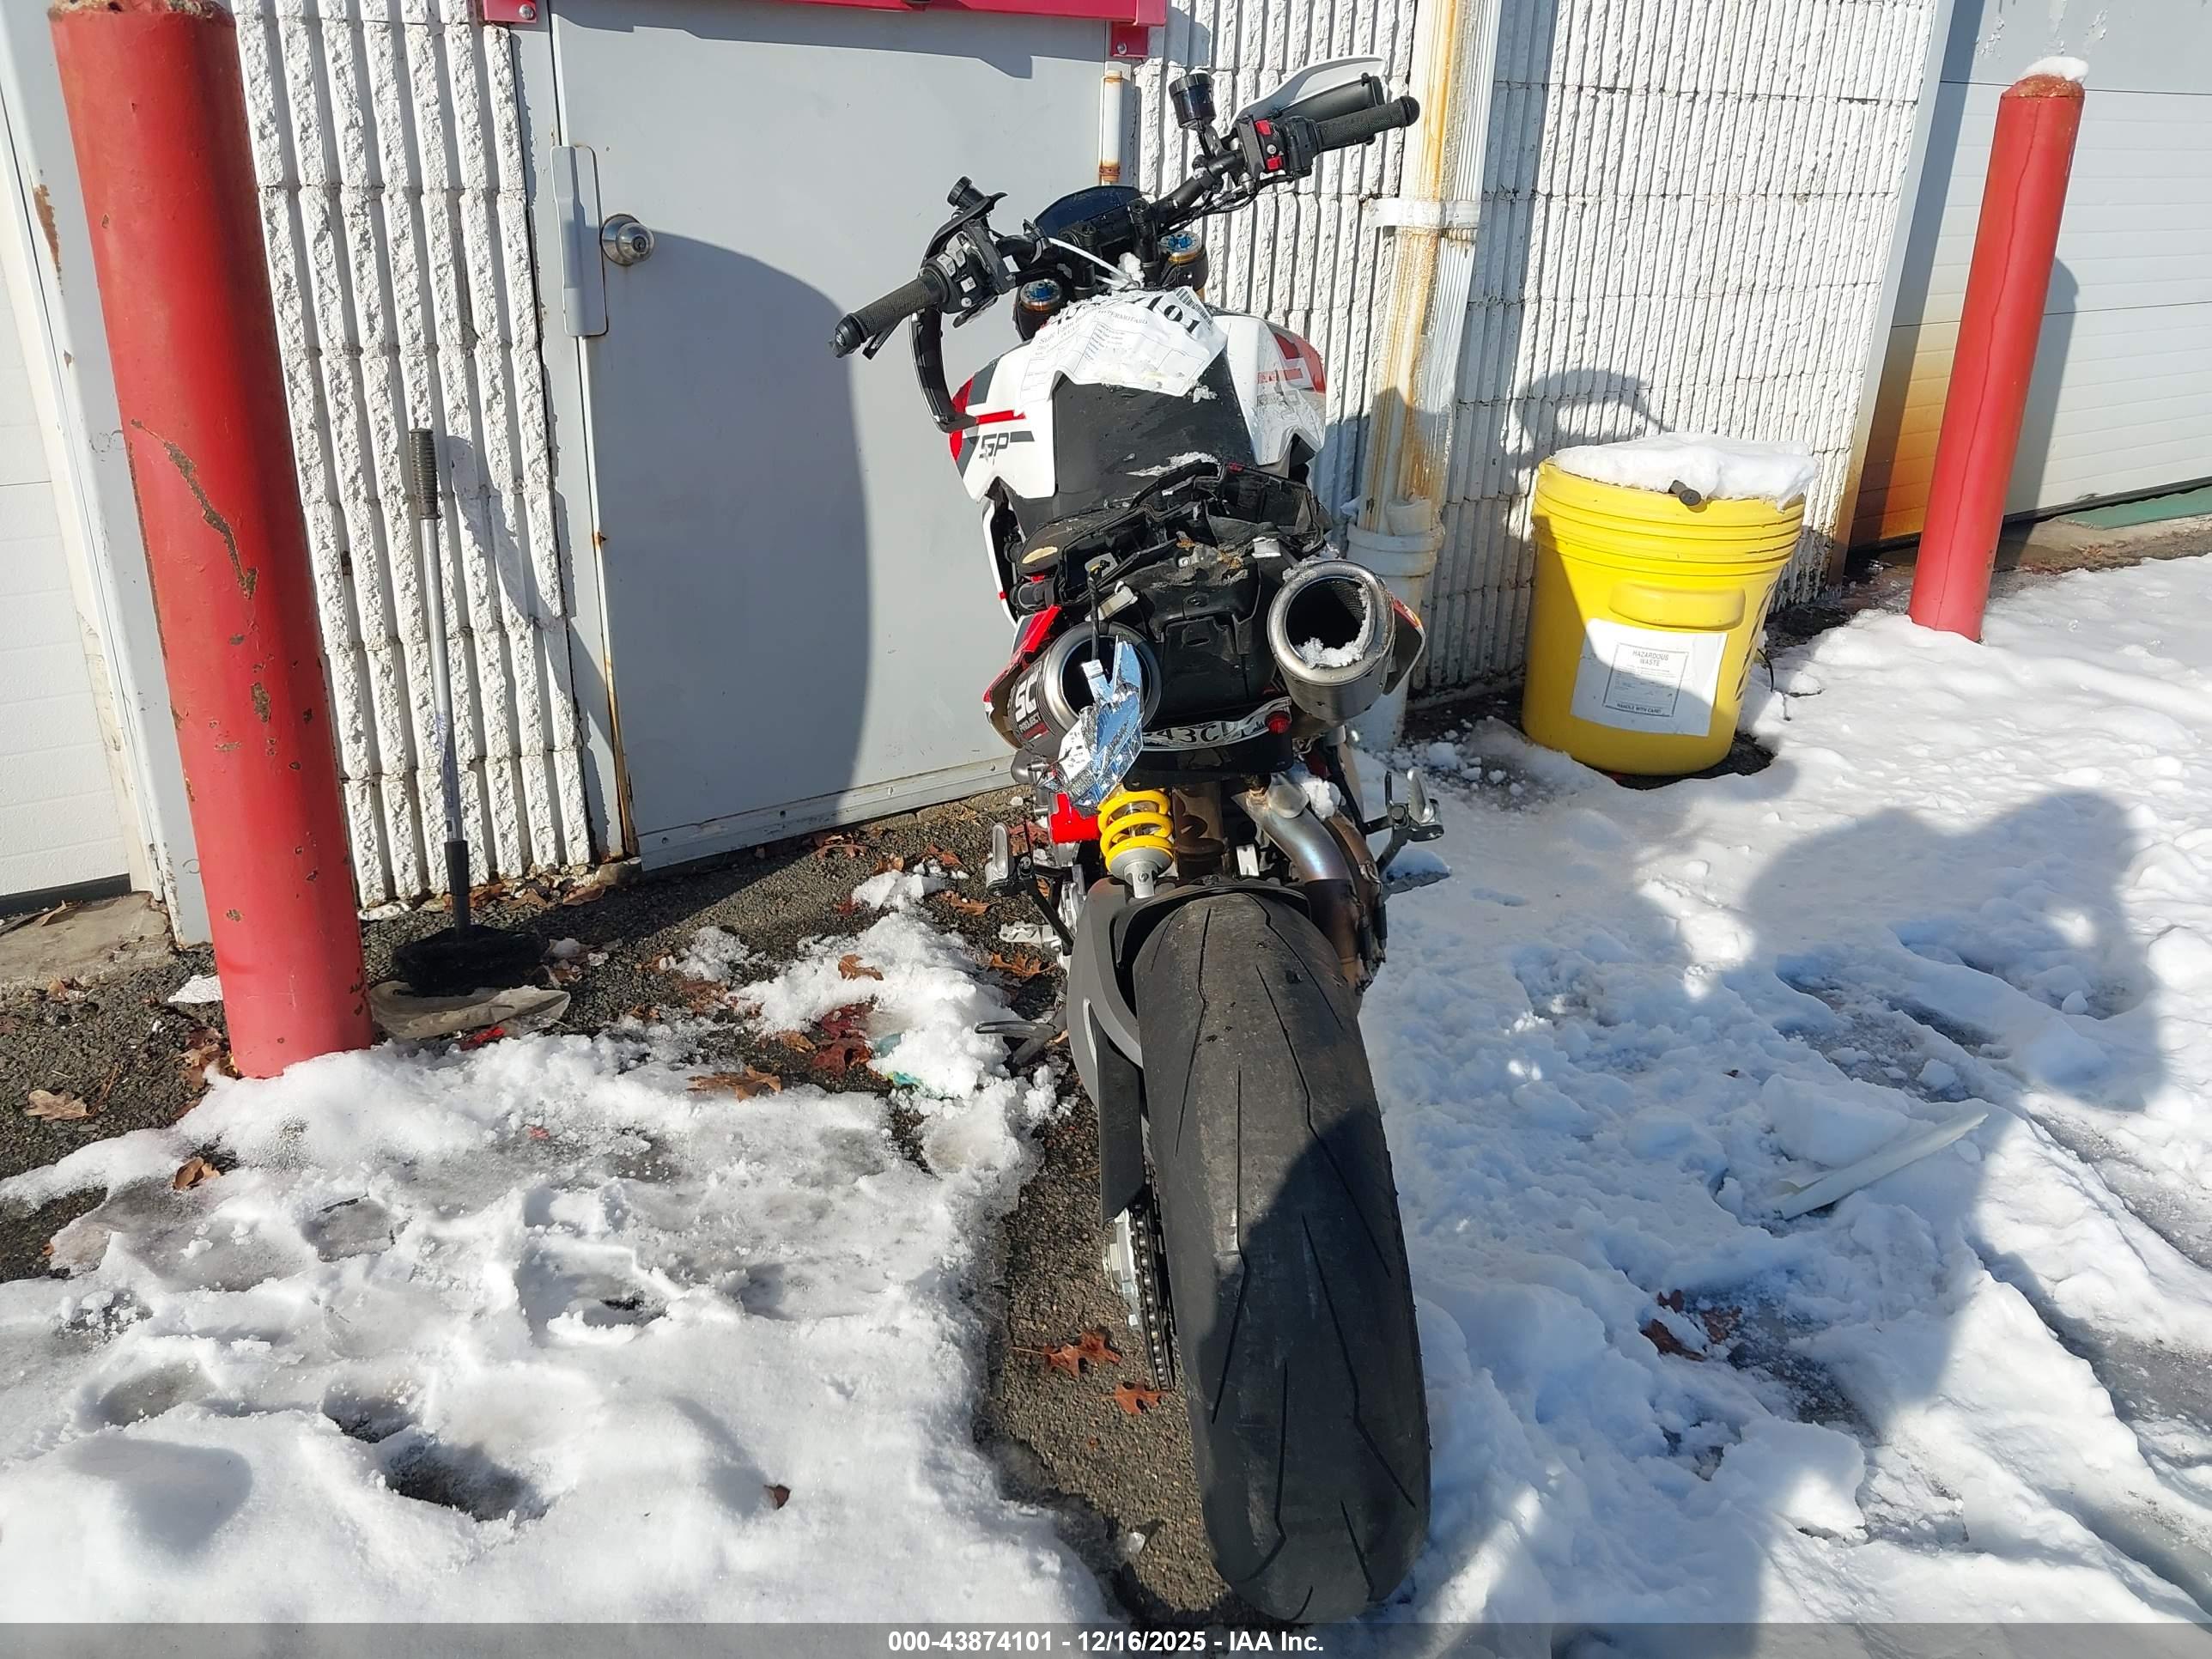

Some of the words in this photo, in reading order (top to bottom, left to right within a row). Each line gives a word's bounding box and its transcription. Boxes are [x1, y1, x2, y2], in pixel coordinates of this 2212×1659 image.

[1632, 650, 1669, 661] HAZARDOUS
[1015, 671, 1039, 723] SC
[1018, 712, 1042, 733] PROJECT
